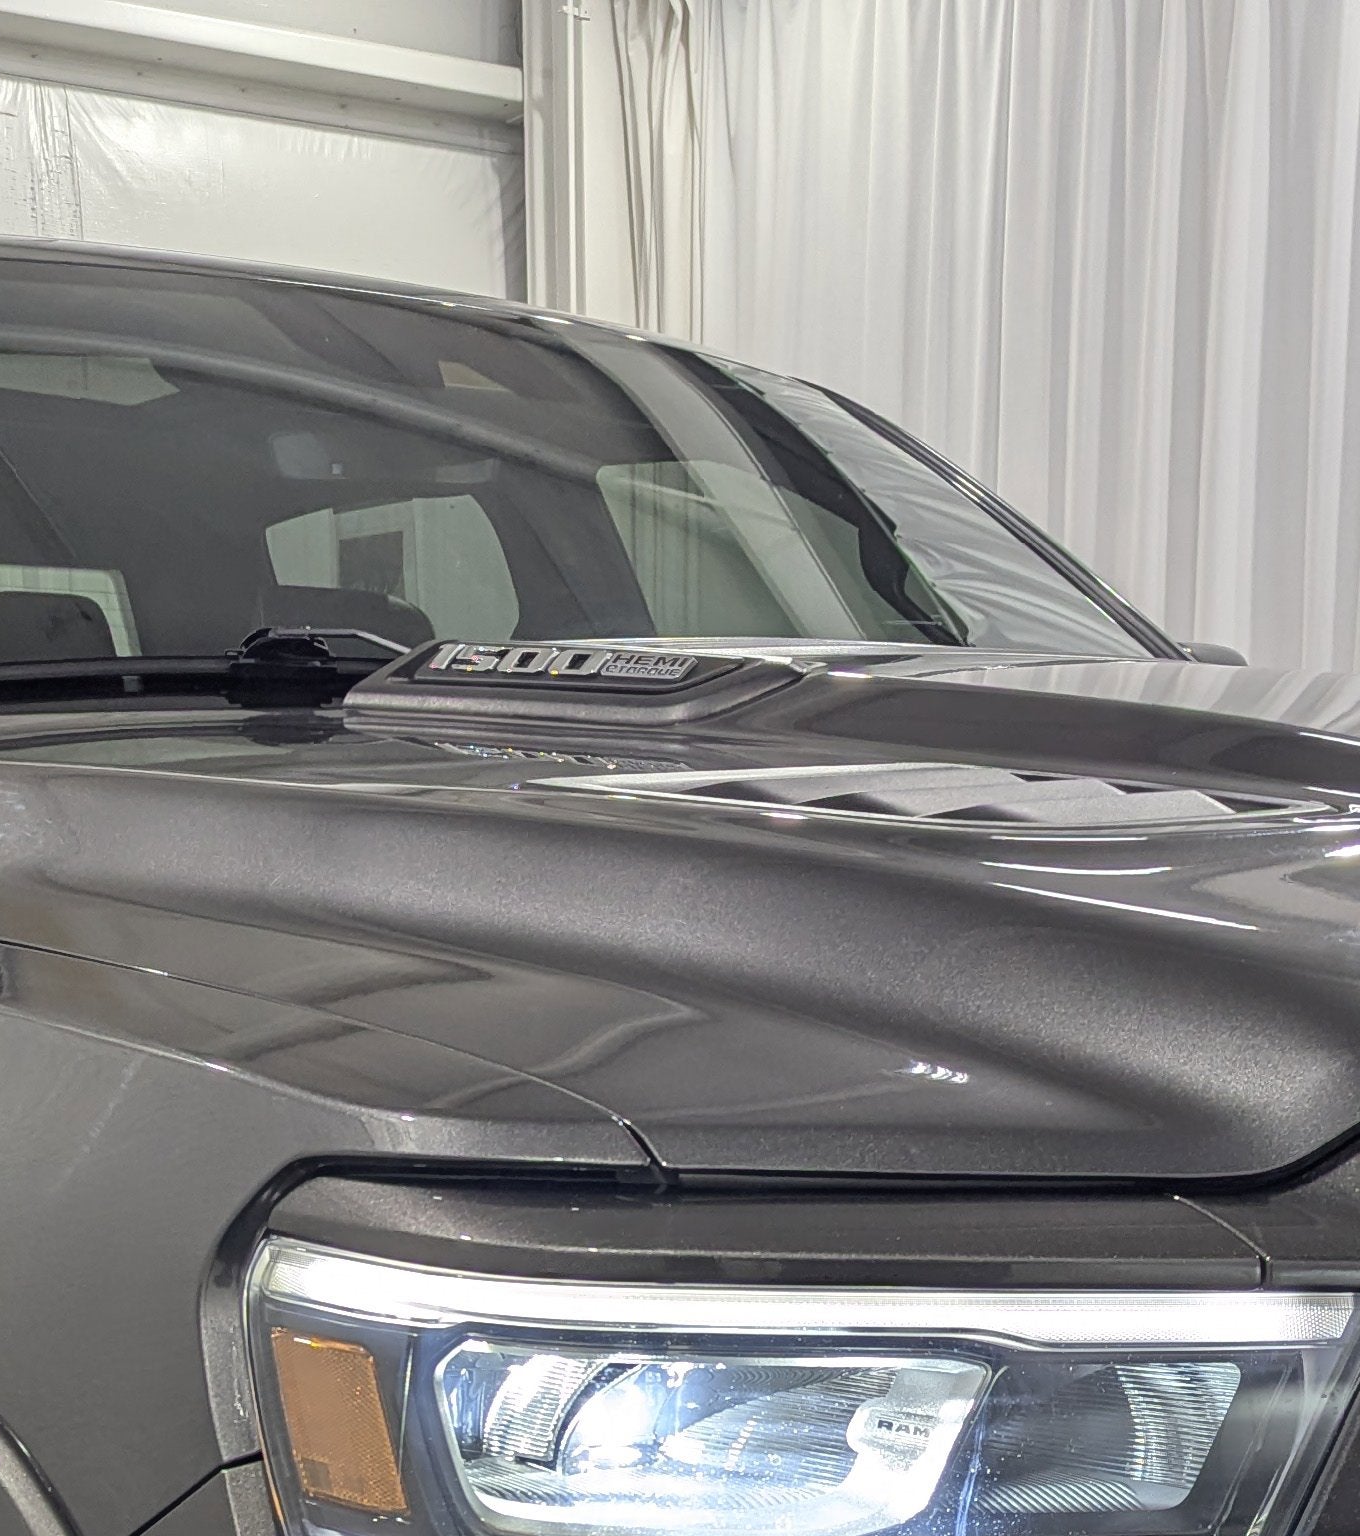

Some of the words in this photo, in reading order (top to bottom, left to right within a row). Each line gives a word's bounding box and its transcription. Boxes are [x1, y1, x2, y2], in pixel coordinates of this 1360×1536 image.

[428, 643, 613, 677] 1500
[612, 654, 690, 668] HEMI
[877, 1419, 931, 1438] RAM
